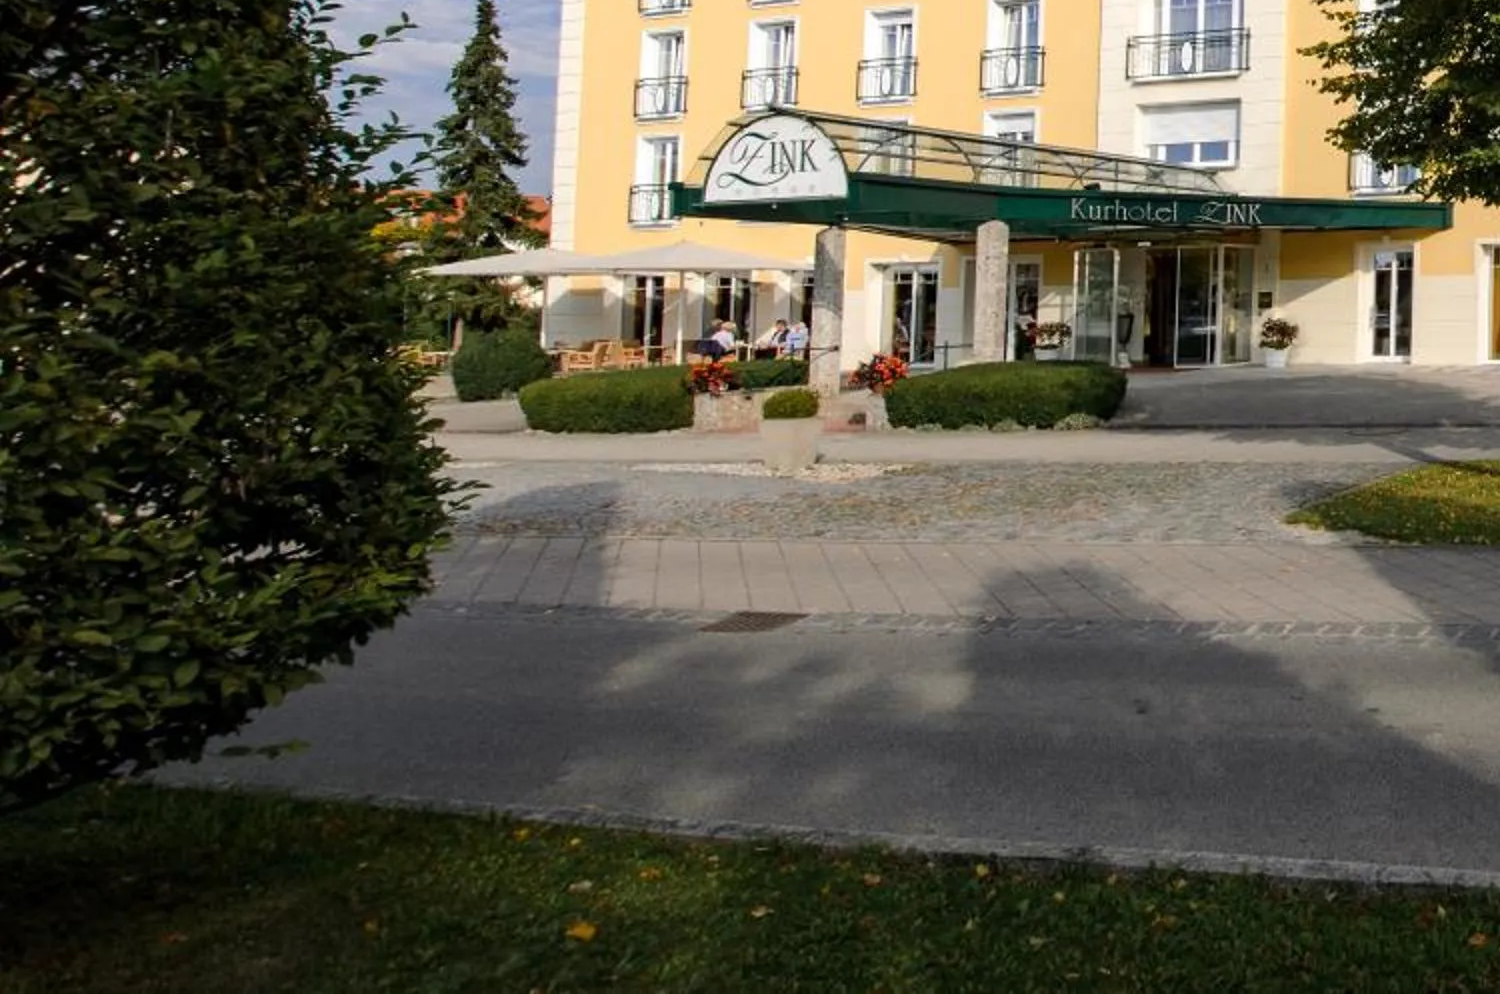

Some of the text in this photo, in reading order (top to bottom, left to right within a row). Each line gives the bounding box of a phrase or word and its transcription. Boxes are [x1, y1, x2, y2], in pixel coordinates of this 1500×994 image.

[717, 132, 819, 188] ZINK
[1070, 197, 1263, 225] Kurhotel ZINK
